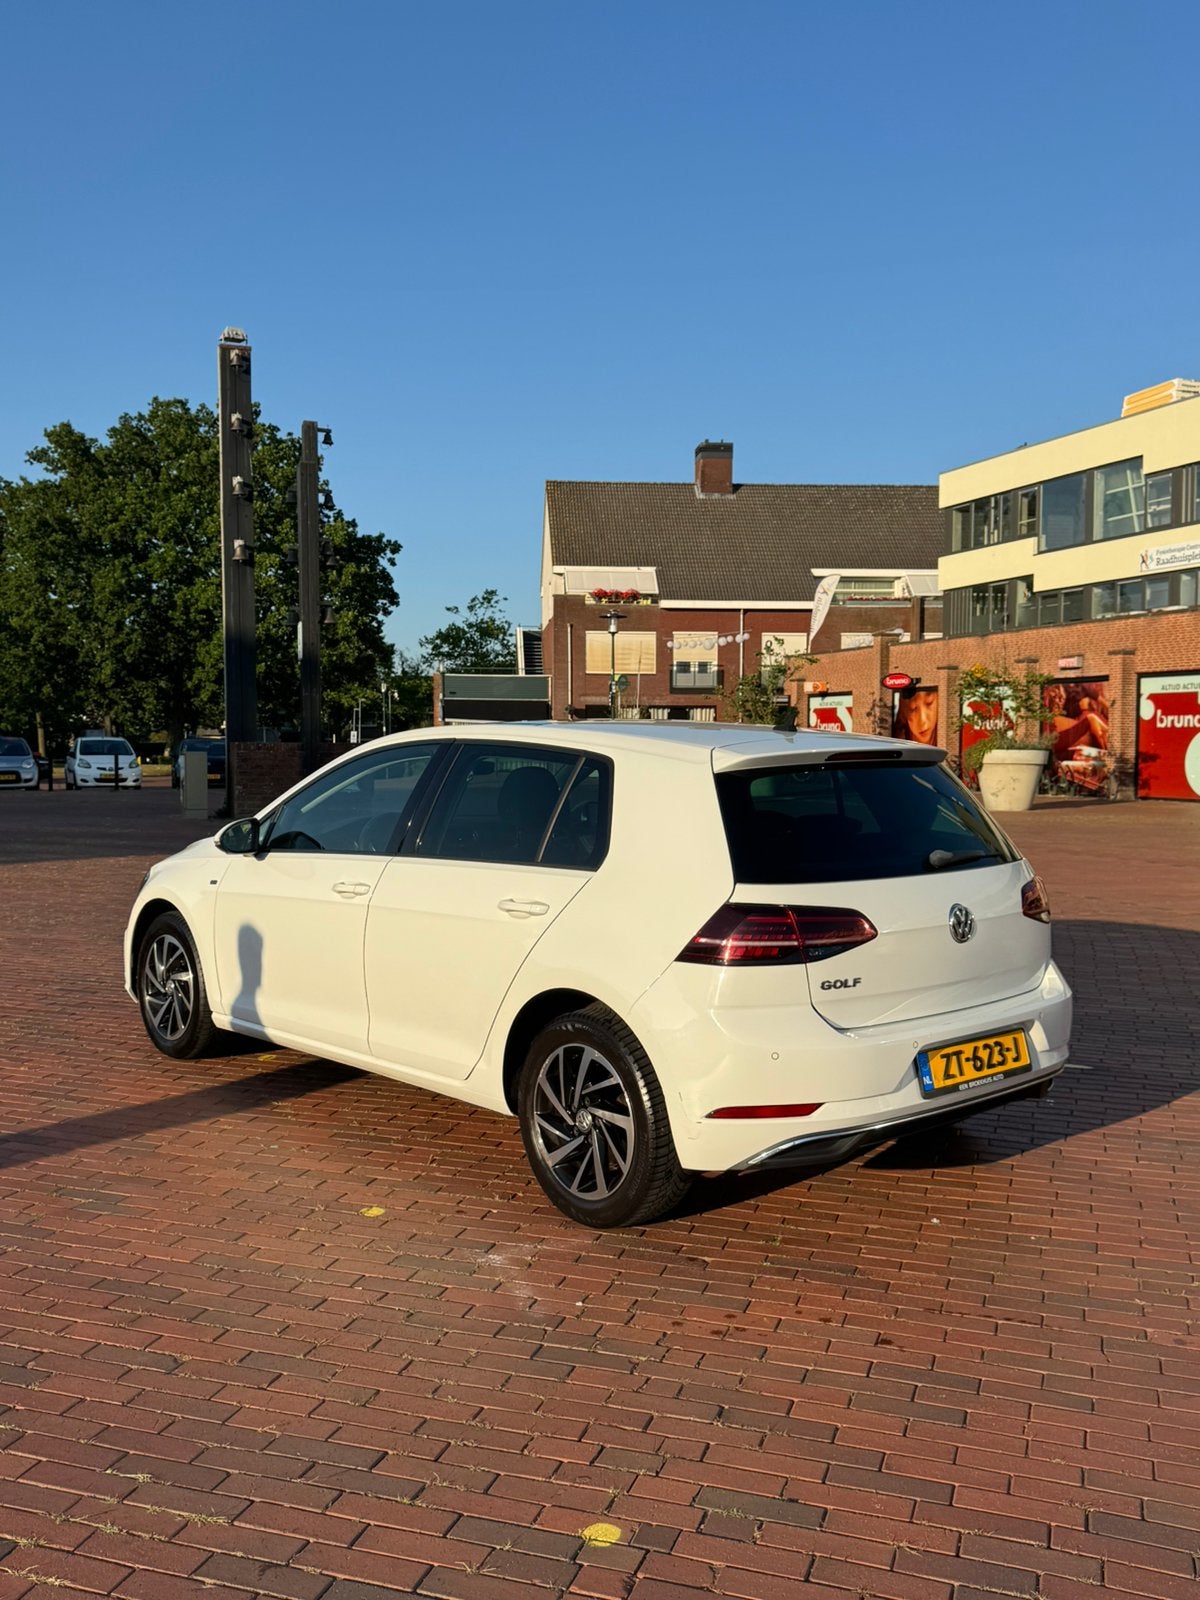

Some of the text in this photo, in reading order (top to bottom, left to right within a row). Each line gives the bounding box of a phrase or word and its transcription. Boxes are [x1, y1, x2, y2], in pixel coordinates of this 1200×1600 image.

[820, 977, 862, 990] GOLF
[940, 1036, 1022, 1081] ZT-623-J
[923, 1076, 932, 1085] NL
